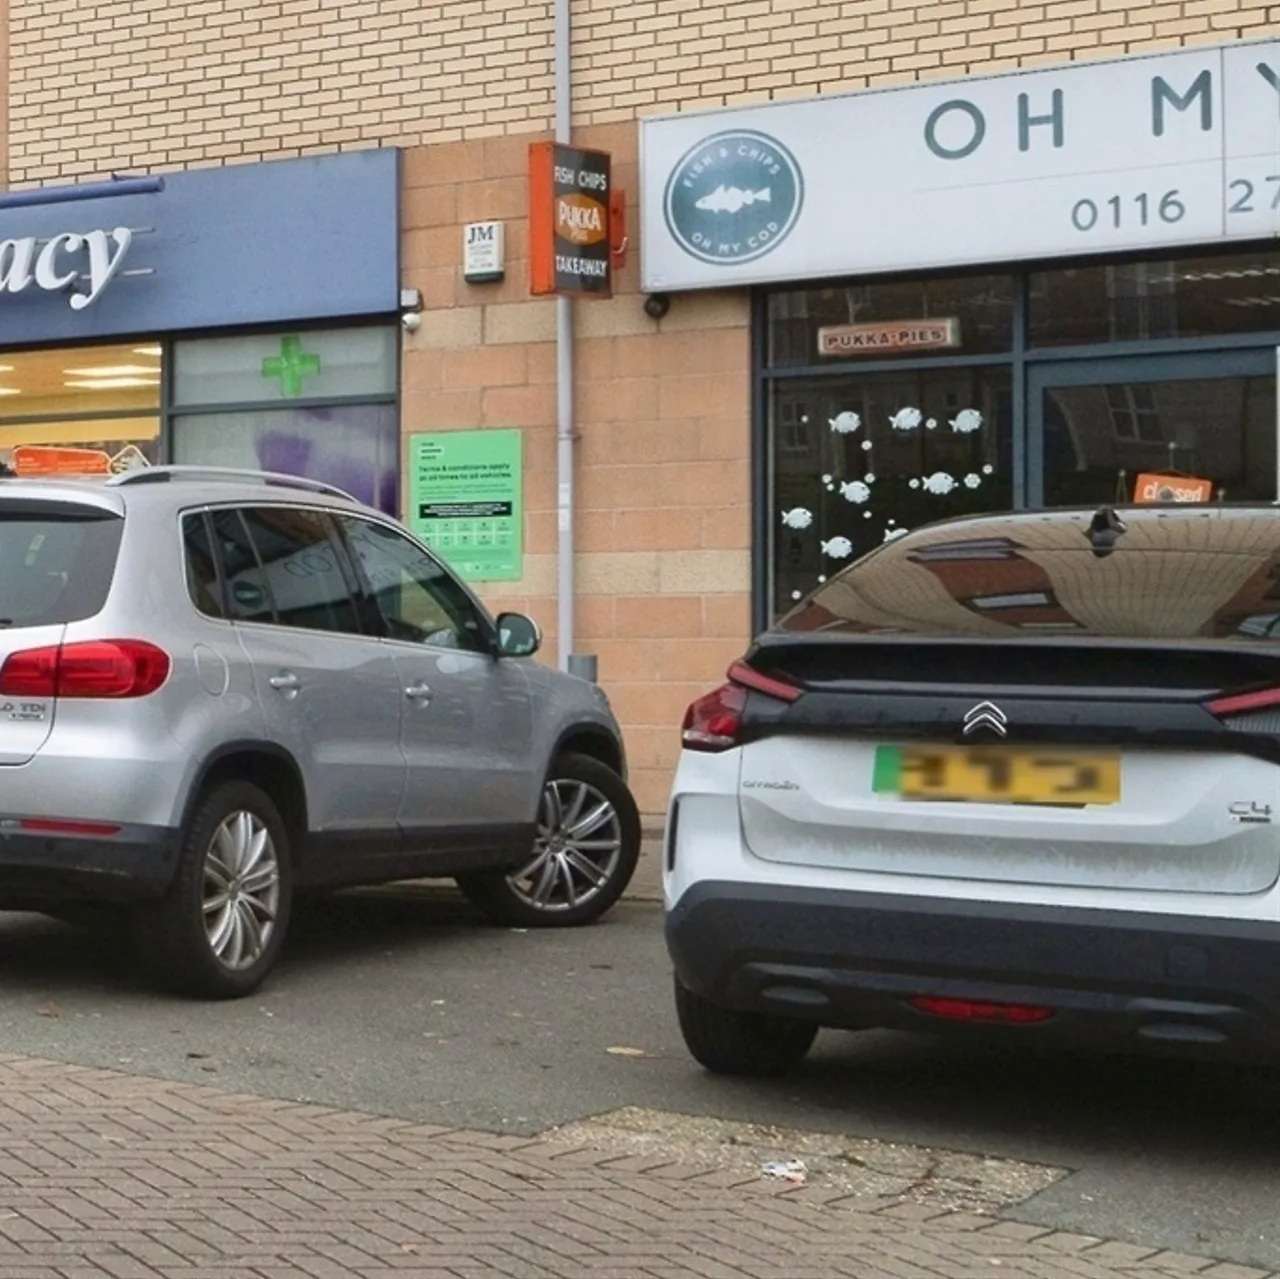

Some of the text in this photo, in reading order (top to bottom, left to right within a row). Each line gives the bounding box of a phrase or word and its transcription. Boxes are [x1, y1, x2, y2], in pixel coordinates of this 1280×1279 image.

[924, 88, 1064, 160] OH
[578, 170, 607, 191] CHIPS
[682, 154, 713, 188] FISH
[737, 144, 782, 175] CHIPS
[559, 200, 601, 232] PUKKA
[1071, 189, 1186, 232] 0116
[467, 225, 494, 244] JM
[691, 221, 779, 254] OH MY COD
[555, 255, 608, 277] TAKEAWAY
